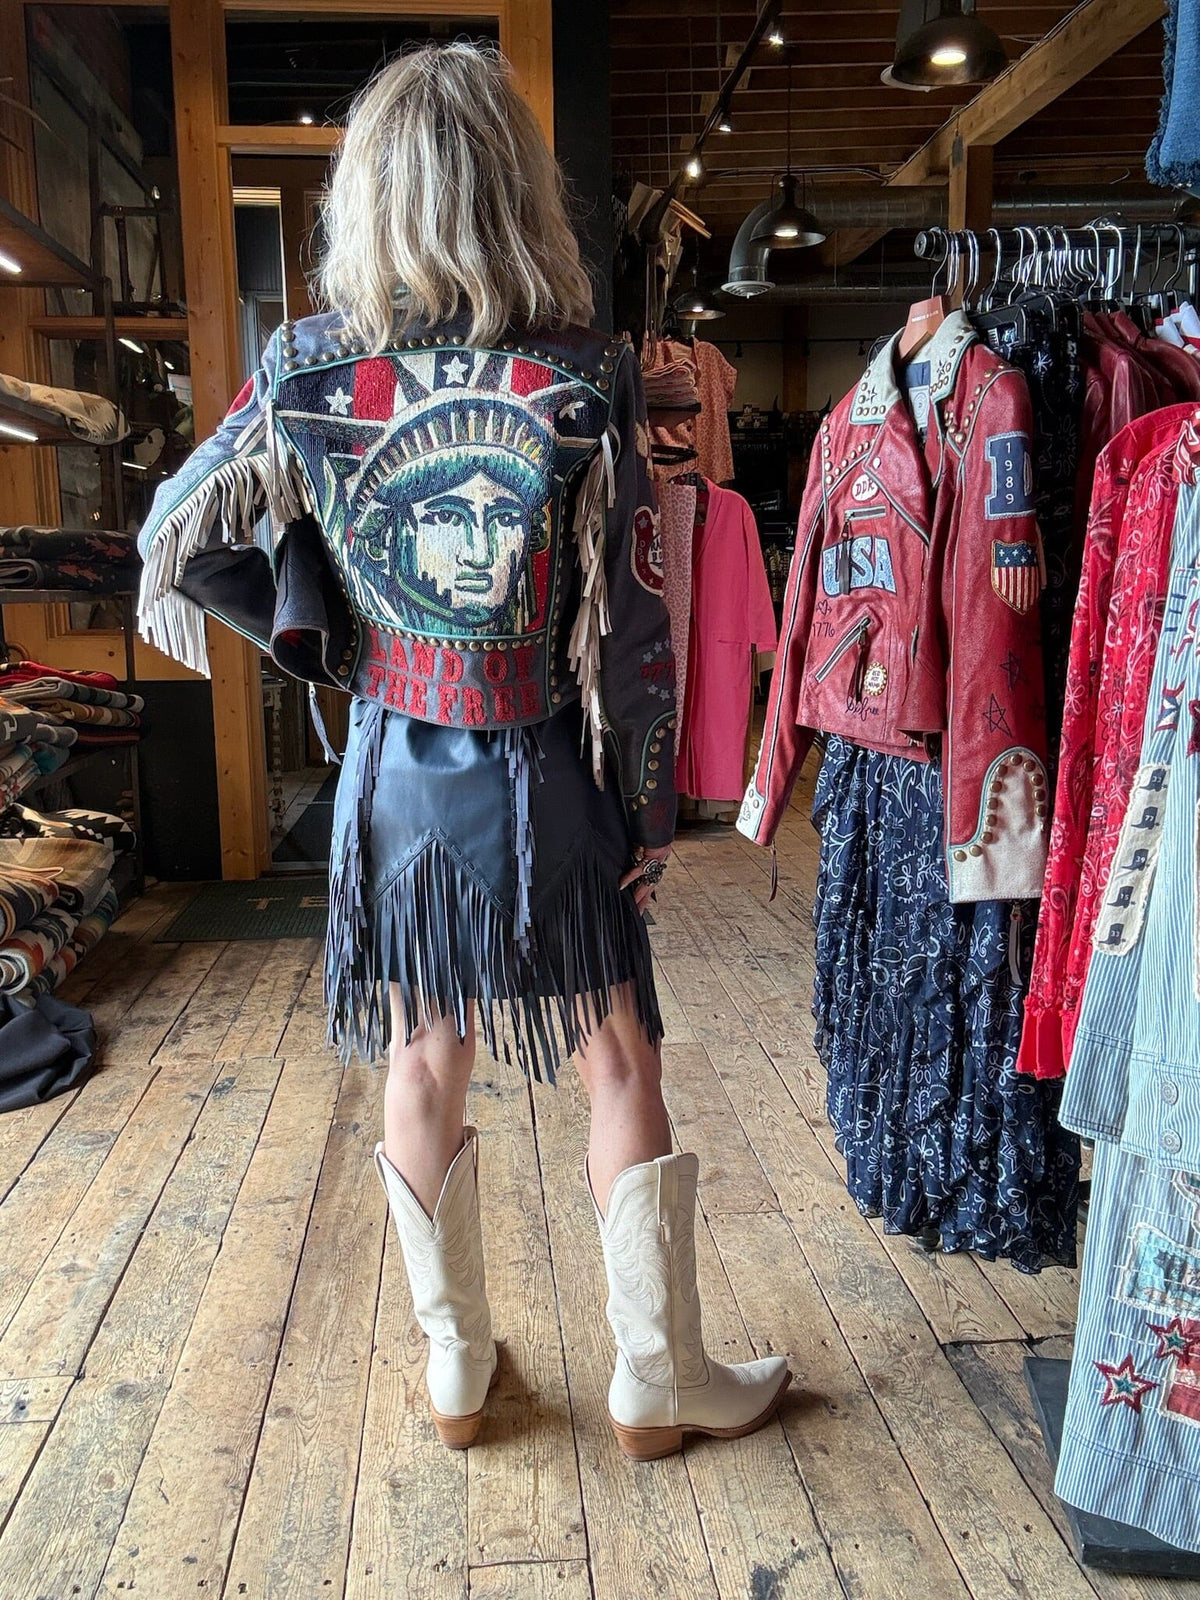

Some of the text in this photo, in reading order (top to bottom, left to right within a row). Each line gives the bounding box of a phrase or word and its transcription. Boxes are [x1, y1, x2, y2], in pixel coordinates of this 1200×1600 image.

[822, 535, 897, 597] USA
[368, 627, 536, 684] LAND OF
[812, 621, 836, 638] 1776
[366, 663, 542, 726] THE FREE
